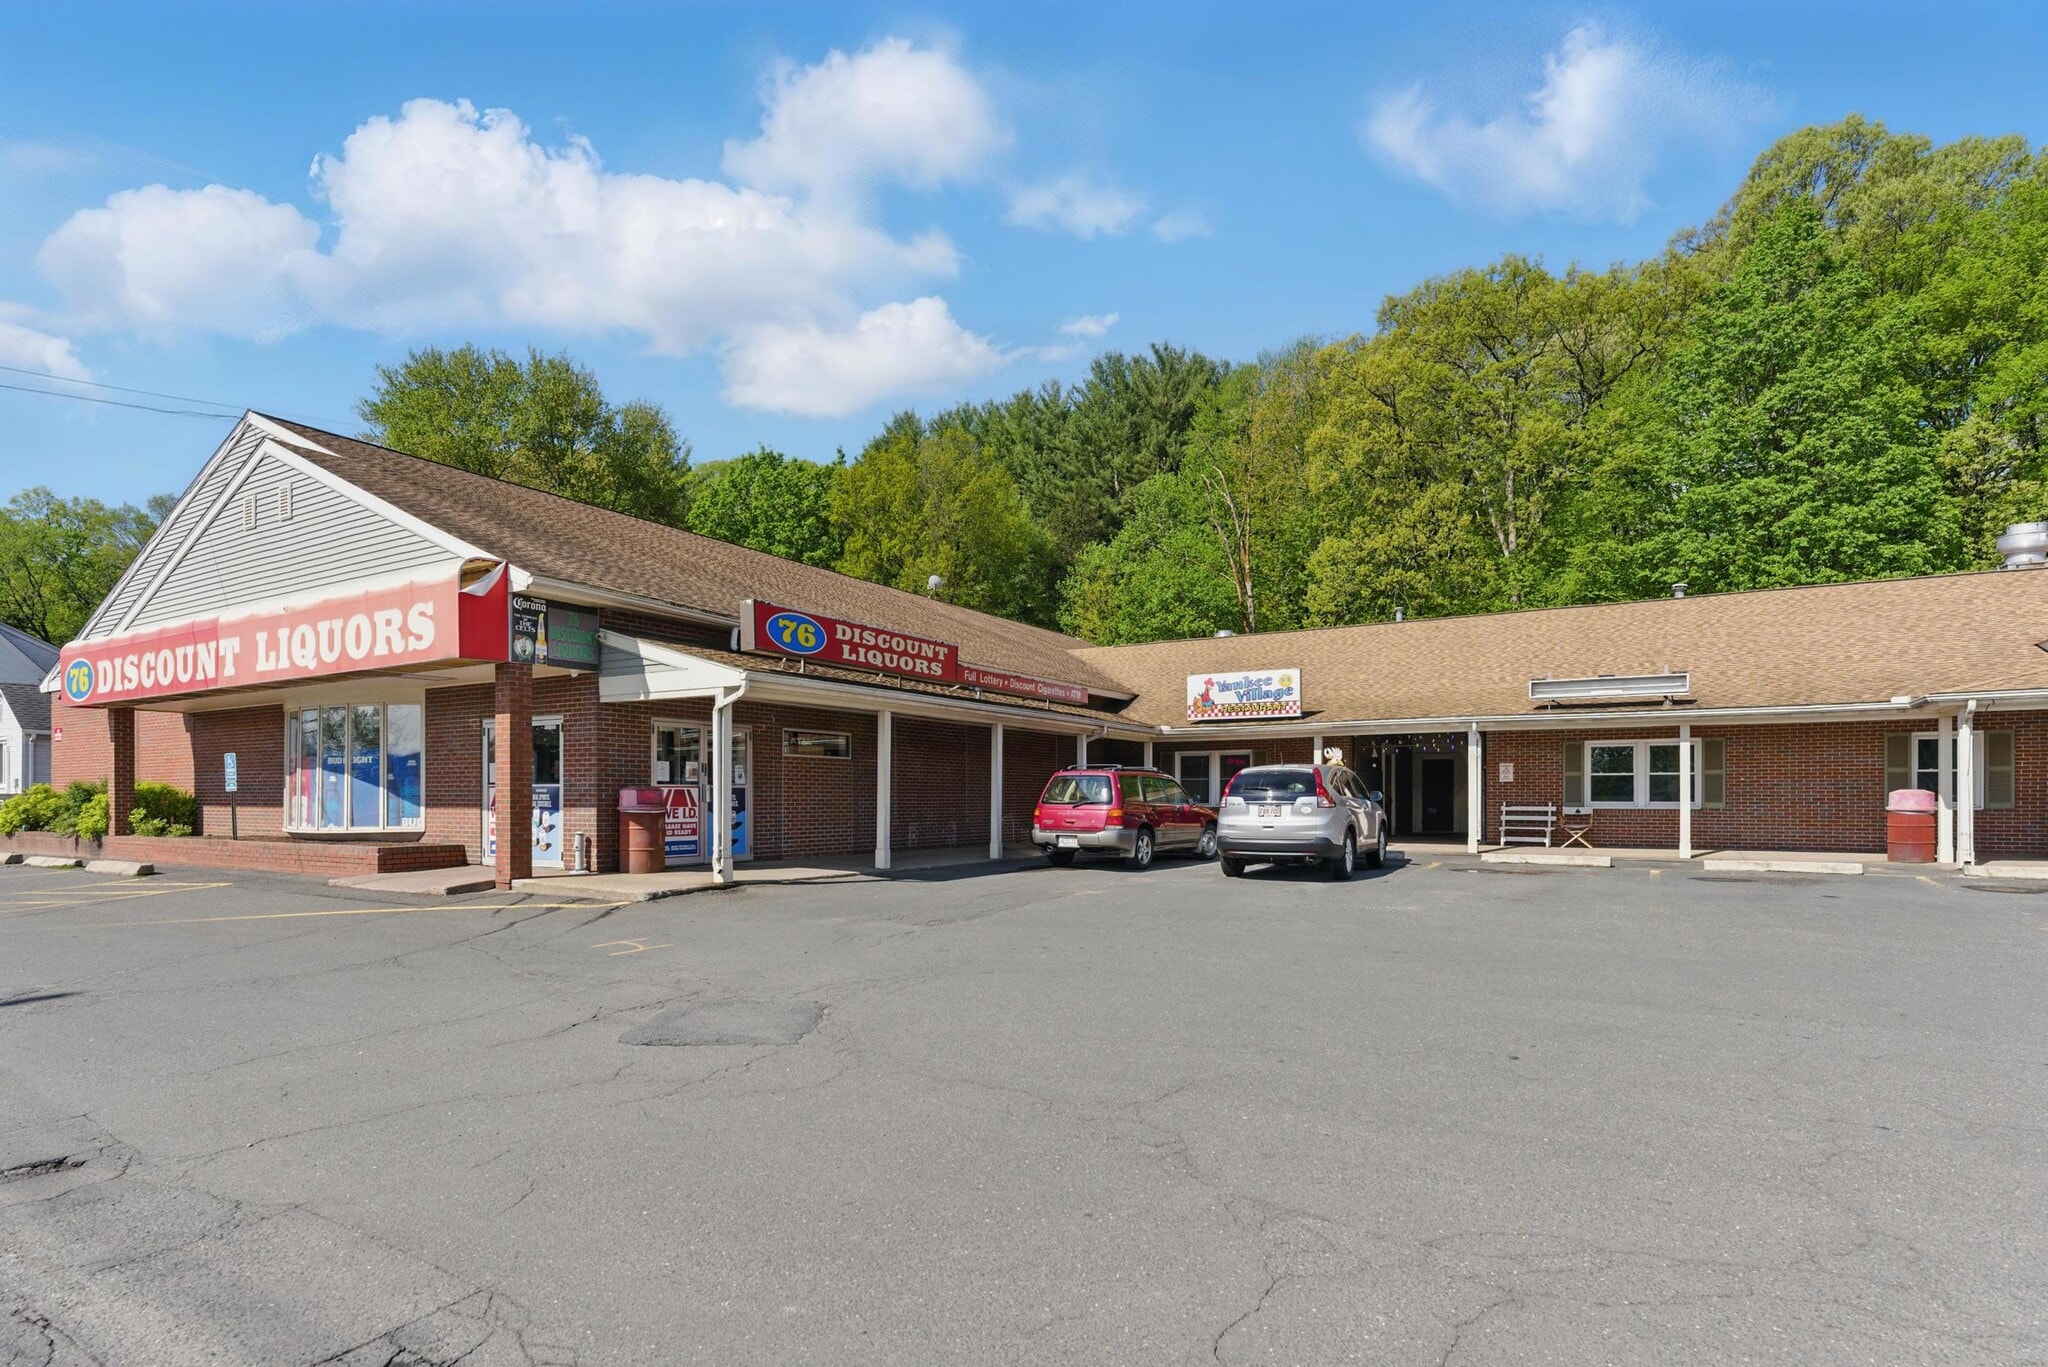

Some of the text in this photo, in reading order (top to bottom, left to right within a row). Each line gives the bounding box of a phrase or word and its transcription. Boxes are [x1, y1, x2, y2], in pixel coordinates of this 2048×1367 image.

[513, 597, 547, 612] Corona
[778, 618, 817, 647] 76
[836, 624, 948, 660] DISCOUNT
[70, 601, 435, 694] 76 DISCOUNT LIQUORS
[842, 644, 943, 676] LIQUORS
[964, 670, 977, 682] Full
[980, 673, 1003, 687] Lottery
[1010, 678, 1035, 691] Discount
[1038, 683, 1066, 698] Cigarettes
[1216, 676, 1273, 692] Yankee
[1235, 686, 1294, 702] Village
[1222, 703, 1288, 713] RESTAURANT
[327, 756, 342, 765] BUD
